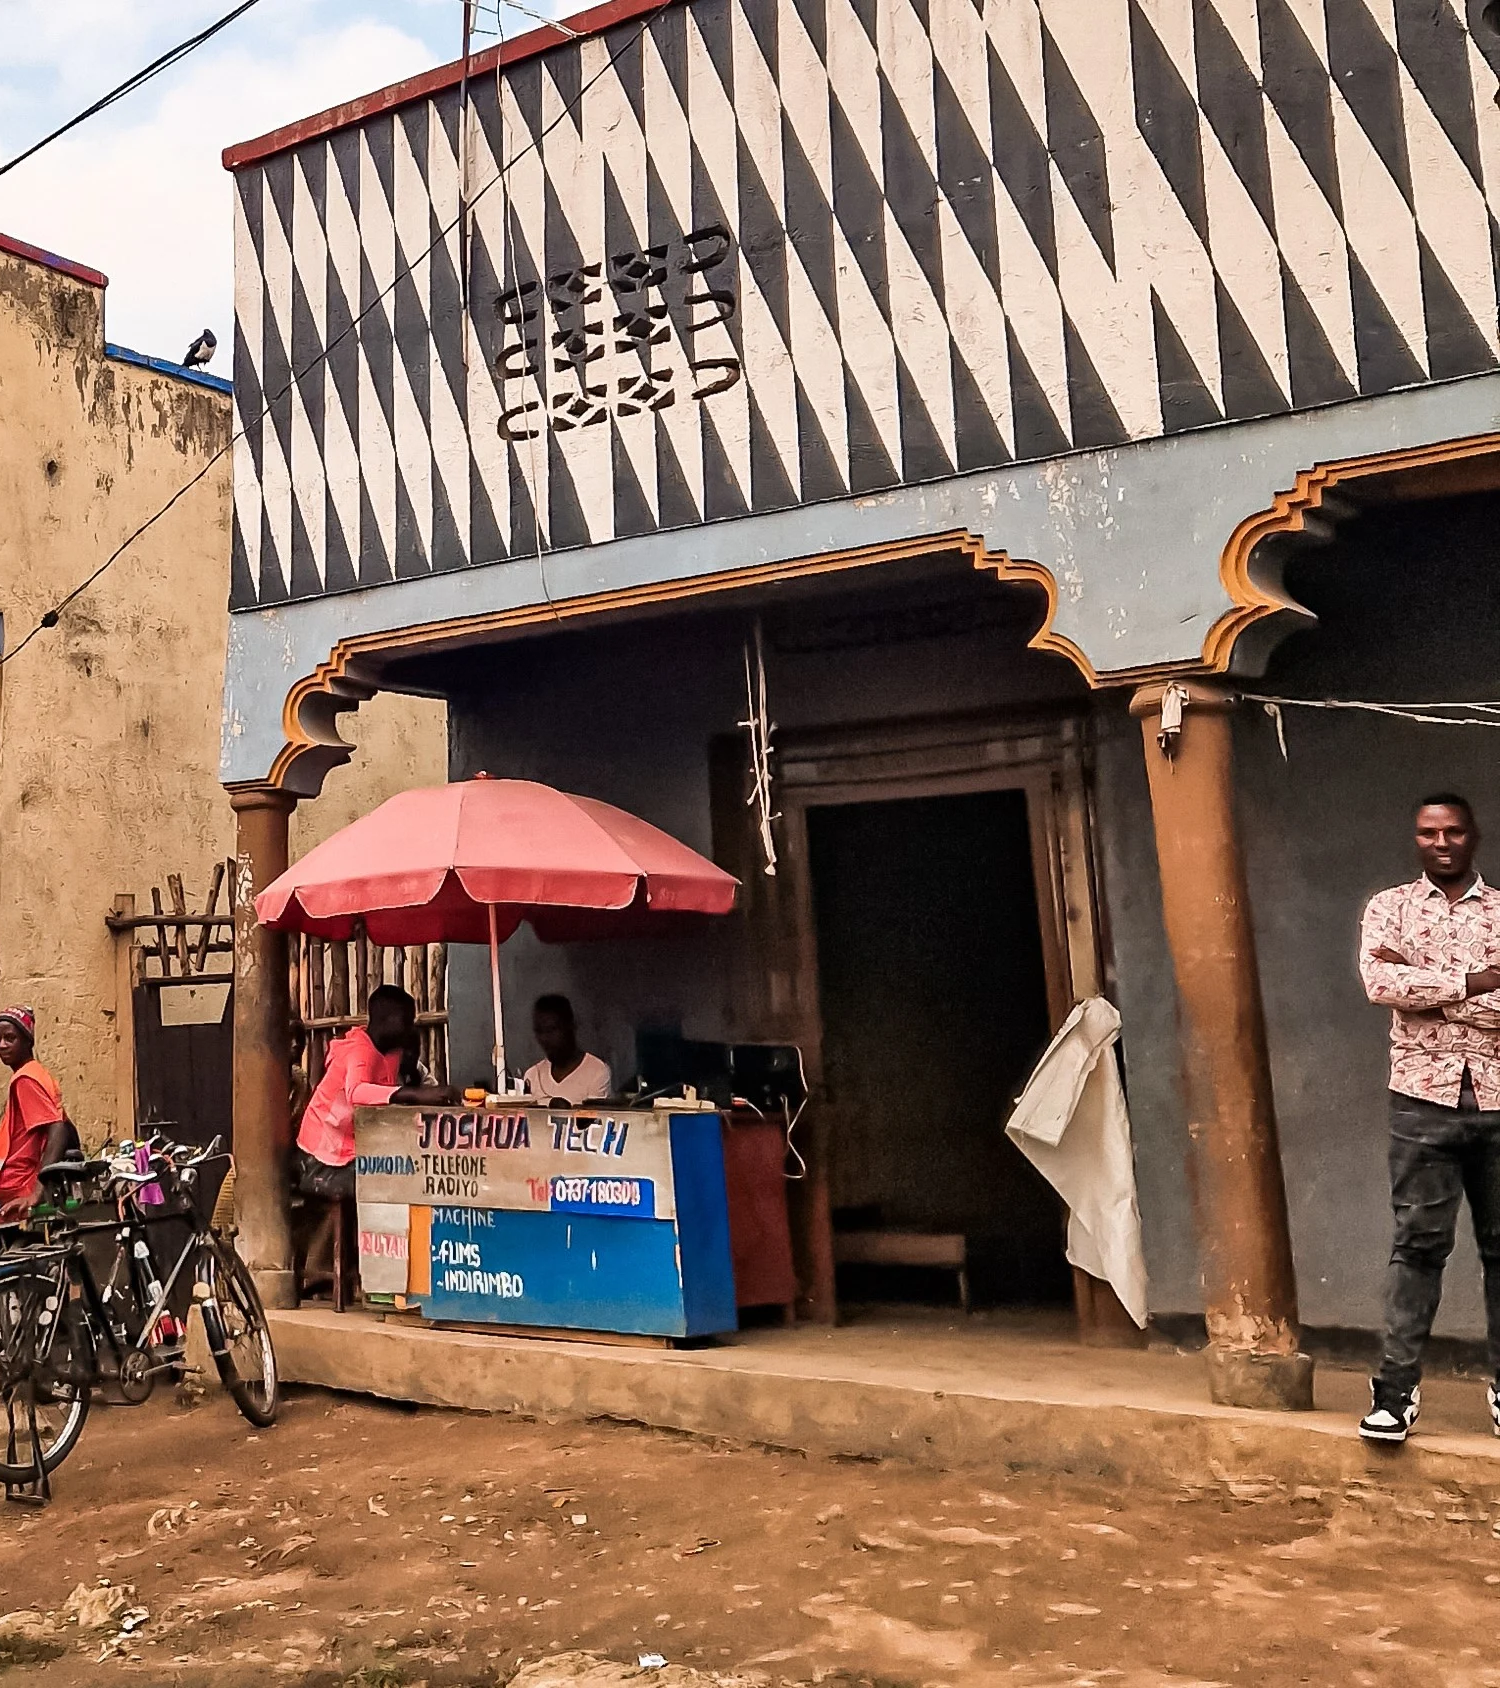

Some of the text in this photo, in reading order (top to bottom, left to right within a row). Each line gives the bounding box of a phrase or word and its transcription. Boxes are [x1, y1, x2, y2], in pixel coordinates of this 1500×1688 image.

[417, 1112, 630, 1157] JOSHUA TECH
[431, 1207, 496, 1228] MACHINE
